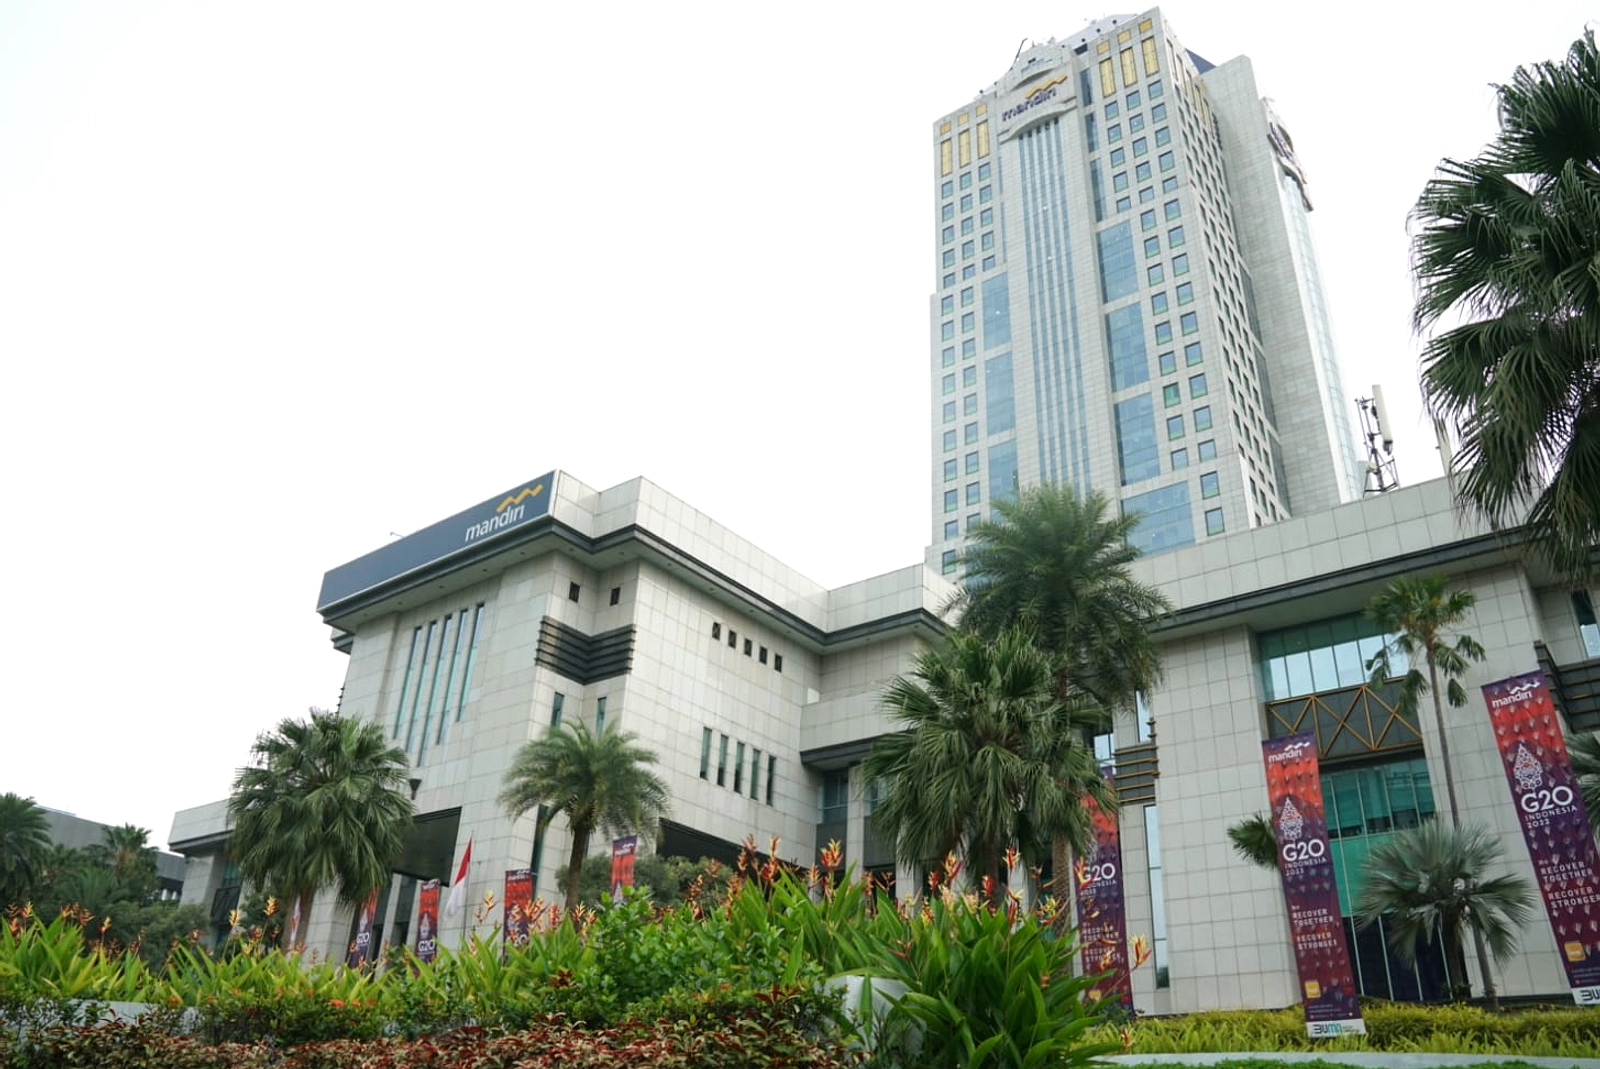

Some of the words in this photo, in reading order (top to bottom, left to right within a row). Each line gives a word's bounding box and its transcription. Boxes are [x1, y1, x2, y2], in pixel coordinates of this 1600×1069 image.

[465, 504, 525, 542] mandiri
[1491, 690, 1532, 708] mandiri
[1521, 786, 1573, 813] G20
[1525, 804, 1577, 821] INDONESIA
[1283, 838, 1325, 862] G20
[1284, 856, 1327, 869] INDONESIA
[1540, 861, 1585, 875] RECOVER
[1542, 867, 1593, 883] TOGETHER
[1547, 886, 1593, 901] RECOVER
[1292, 908, 1328, 919] RECOVER
